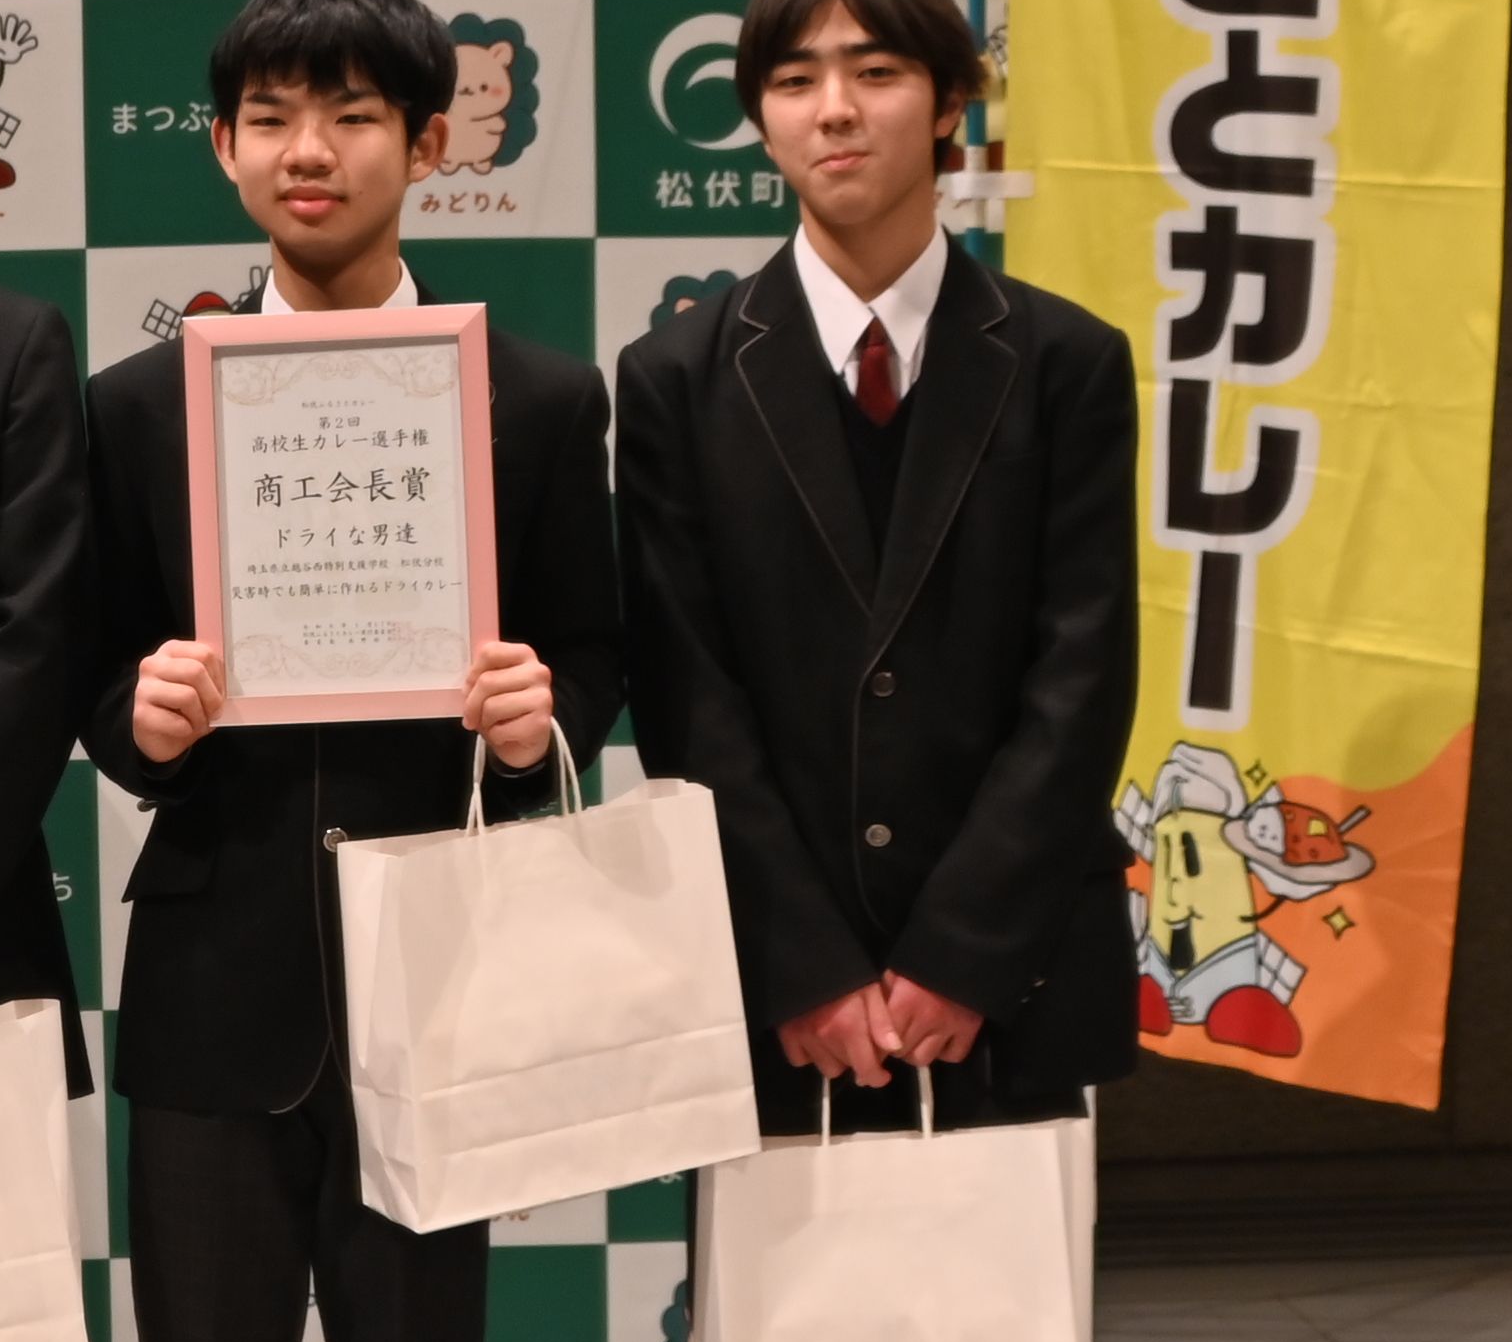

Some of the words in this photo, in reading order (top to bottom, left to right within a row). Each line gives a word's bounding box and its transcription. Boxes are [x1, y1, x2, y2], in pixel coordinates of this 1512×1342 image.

[112, 101, 212, 134] まつぶ
[656, 170, 785, 208] 松伏町
[420, 192, 517, 214] みどりん
[252, 428, 430, 454] 高校生カレー選手権
[254, 466, 430, 508] 商工会長賞
[278, 522, 417, 549] ドライな男達
[232, 580, 462, 600] 災害時でも簡単に作れるドライカレー
